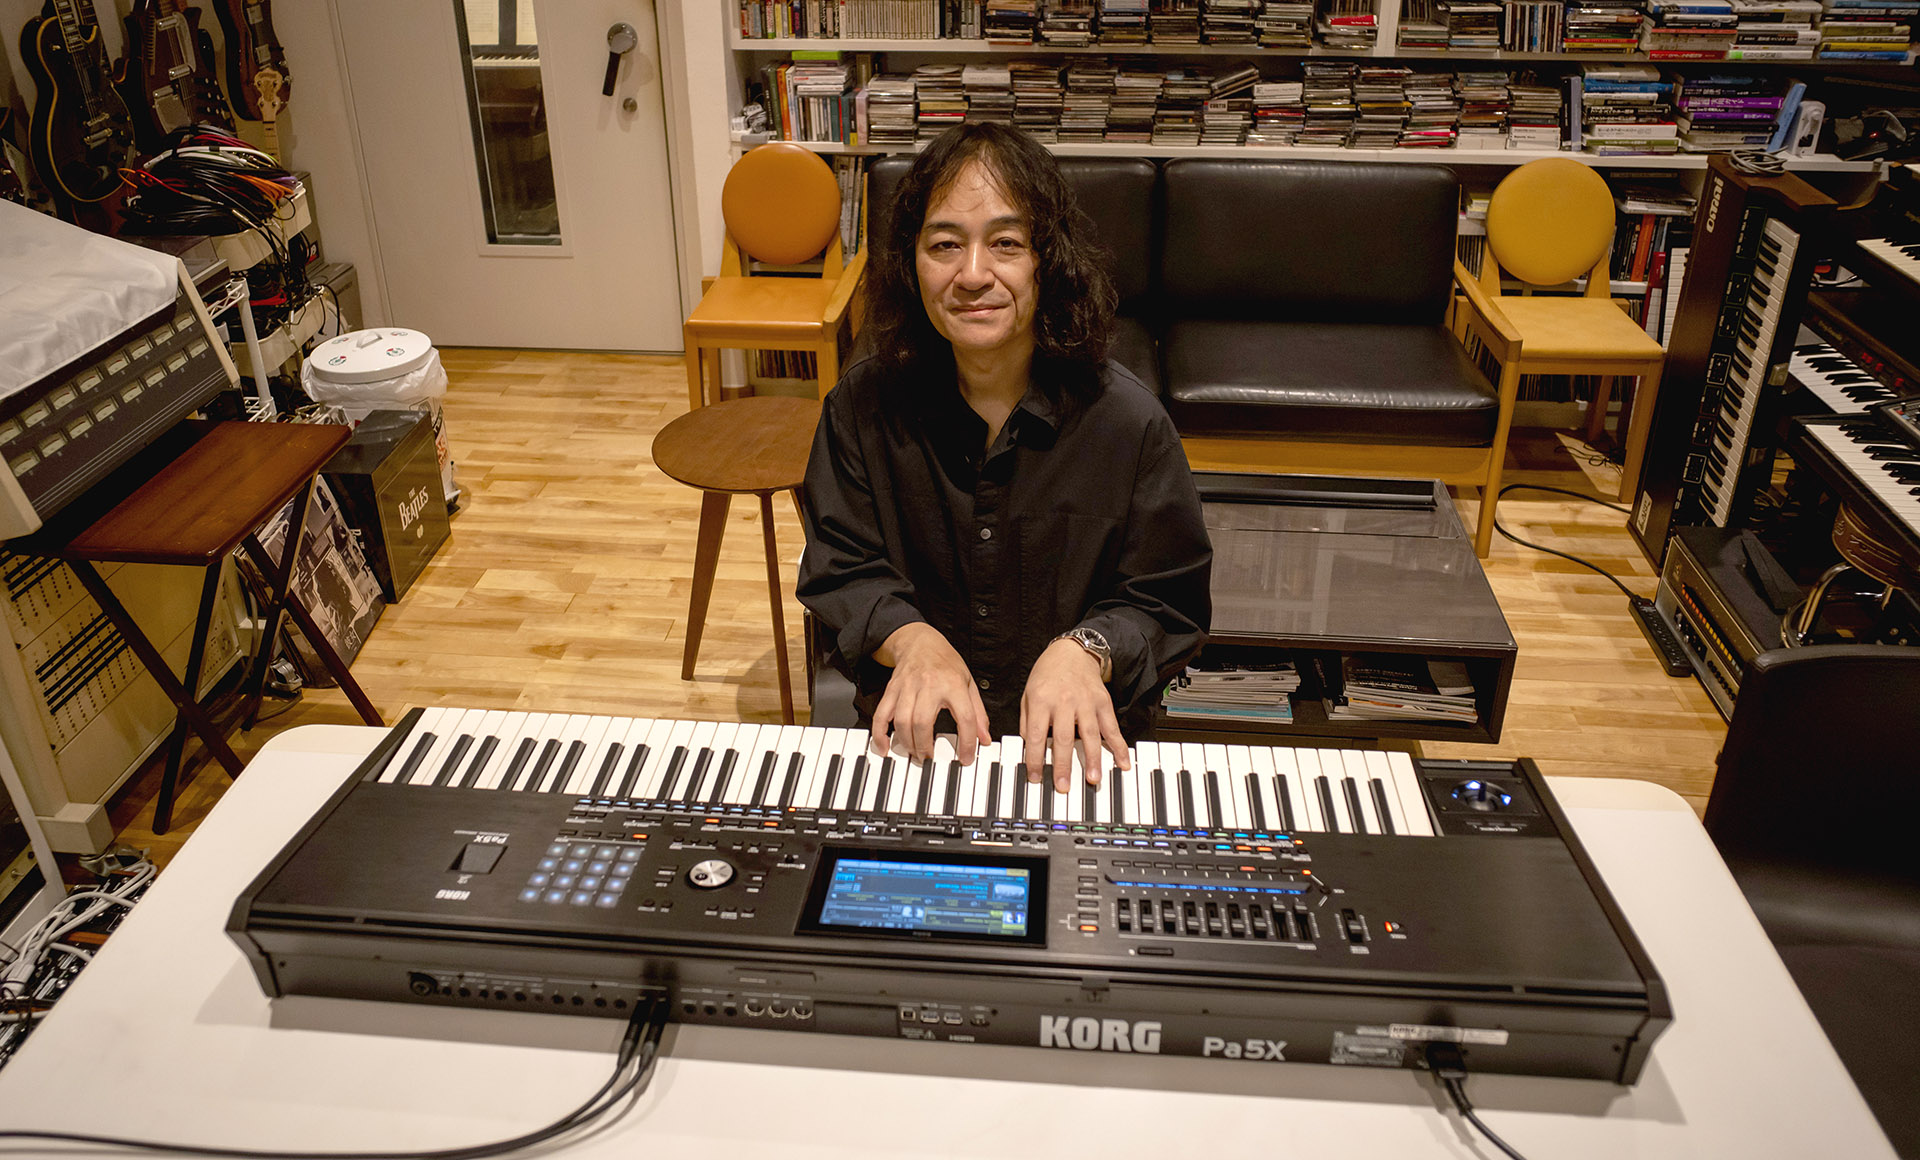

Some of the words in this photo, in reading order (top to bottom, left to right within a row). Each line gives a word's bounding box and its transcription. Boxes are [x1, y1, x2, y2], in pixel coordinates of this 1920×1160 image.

[1706, 176, 1724, 233] omni
[398, 485, 429, 531] BEATLES
[435, 889, 471, 900] KORG
[1040, 1015, 1162, 1053] KORG
[1203, 1036, 1288, 1062] Pa5X
